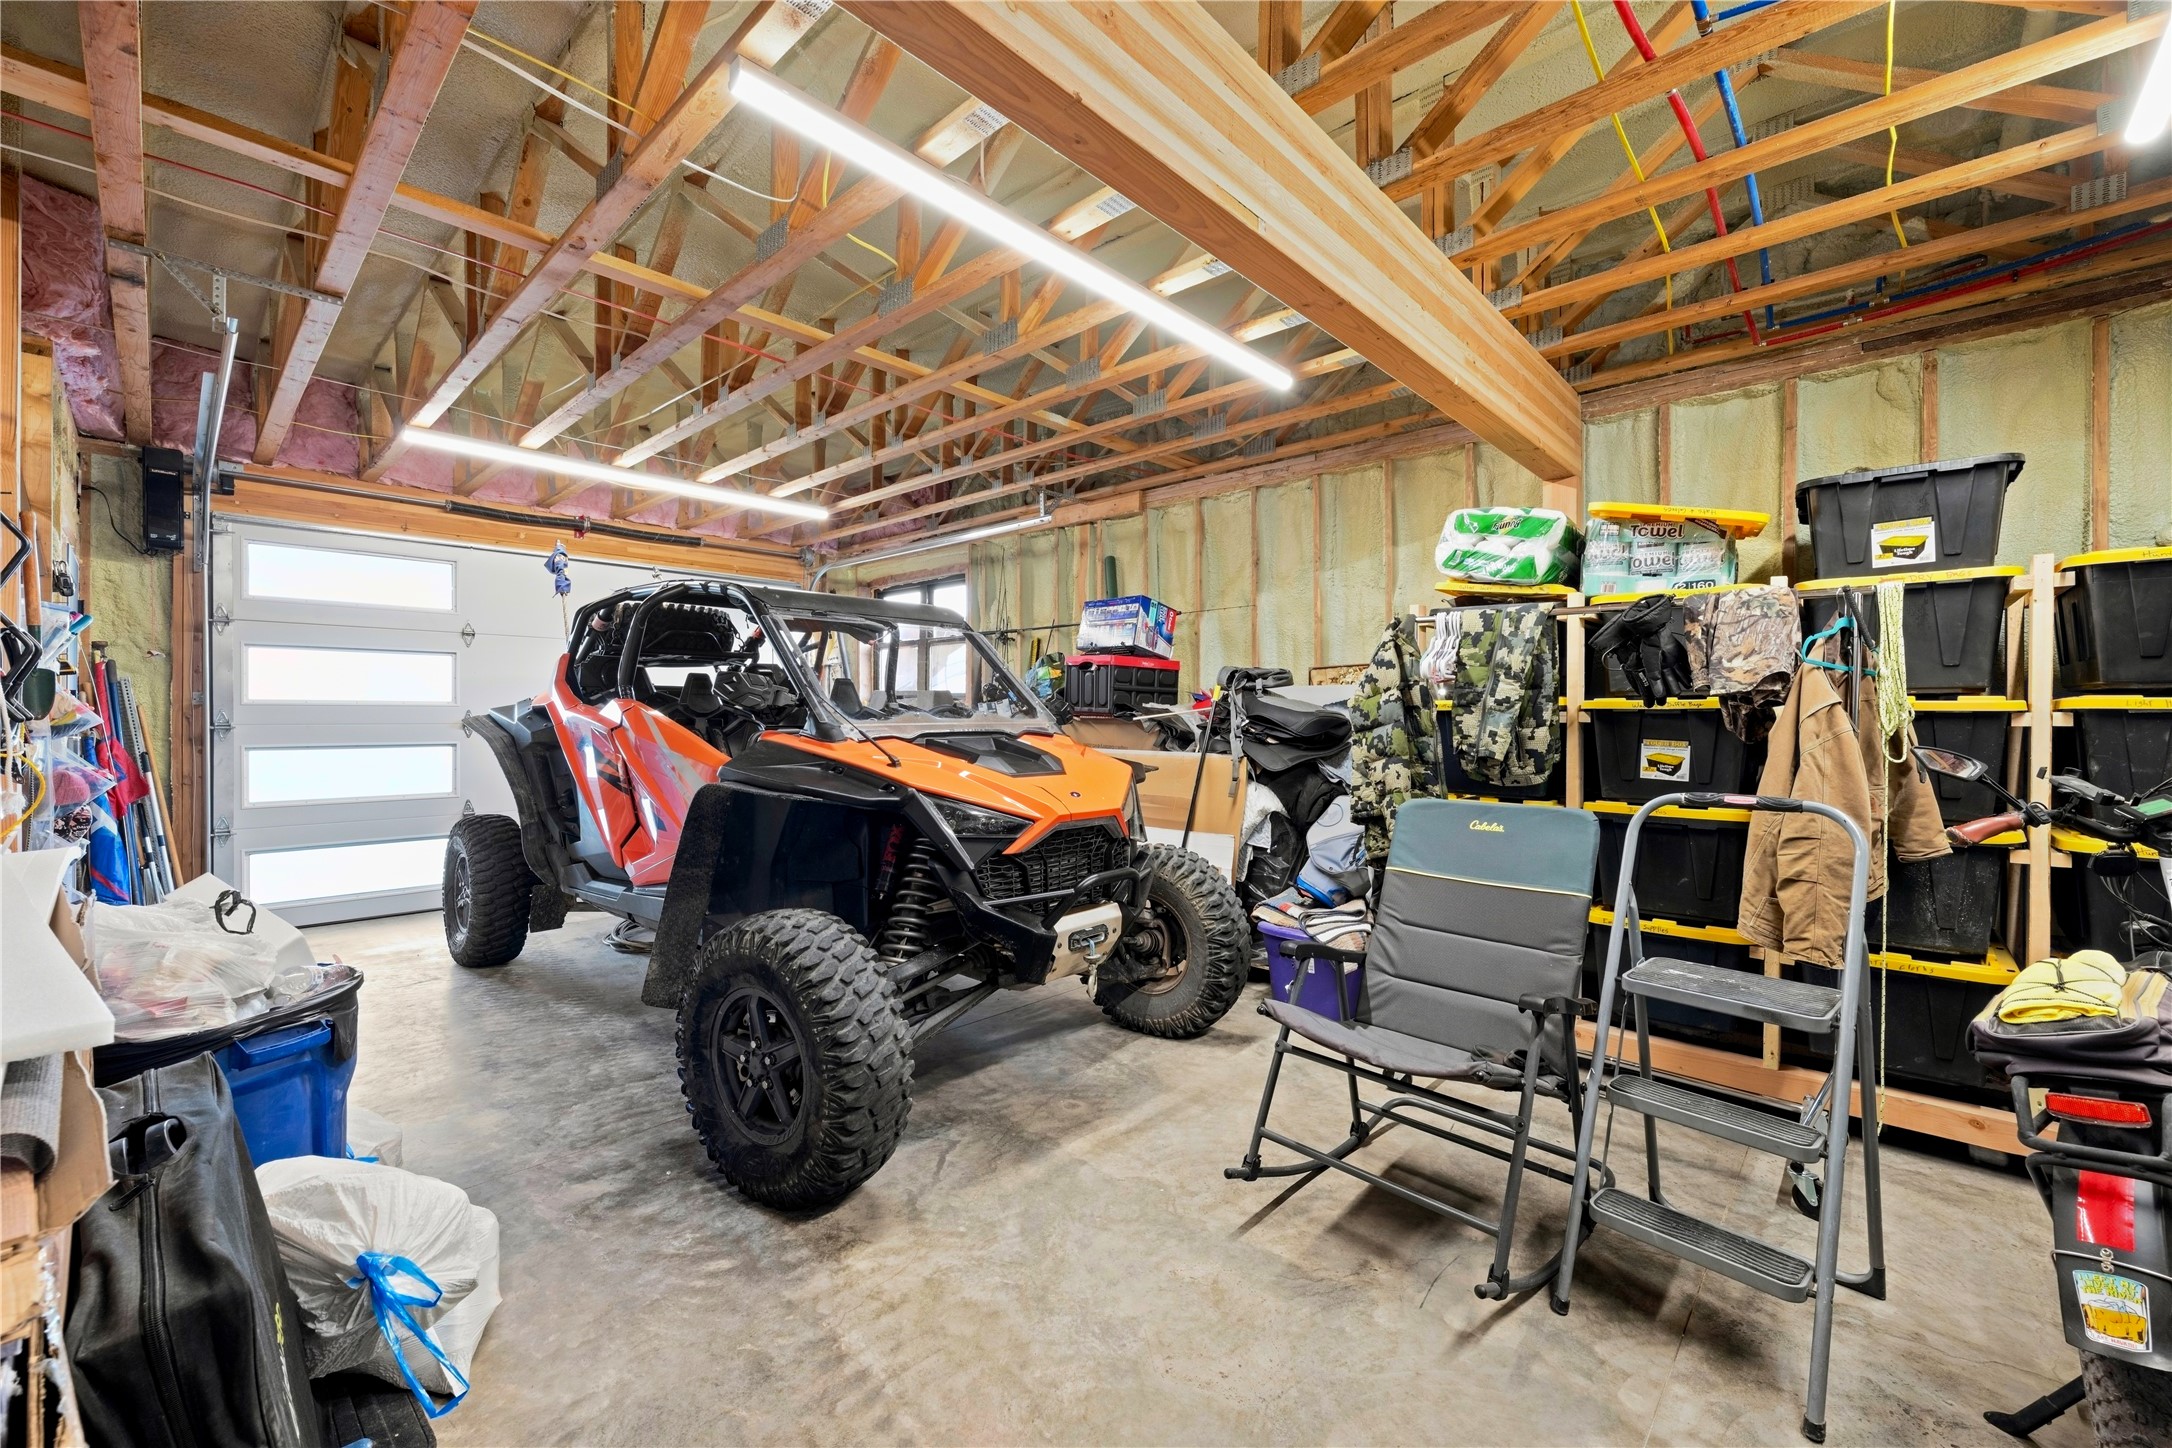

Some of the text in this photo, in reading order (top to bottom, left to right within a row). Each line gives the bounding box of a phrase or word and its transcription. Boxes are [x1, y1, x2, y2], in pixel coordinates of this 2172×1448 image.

[1630, 523, 1684, 538] Towel
[1910, 573, 1934, 582] DRY
[1642, 923, 1669, 934] Supplies
